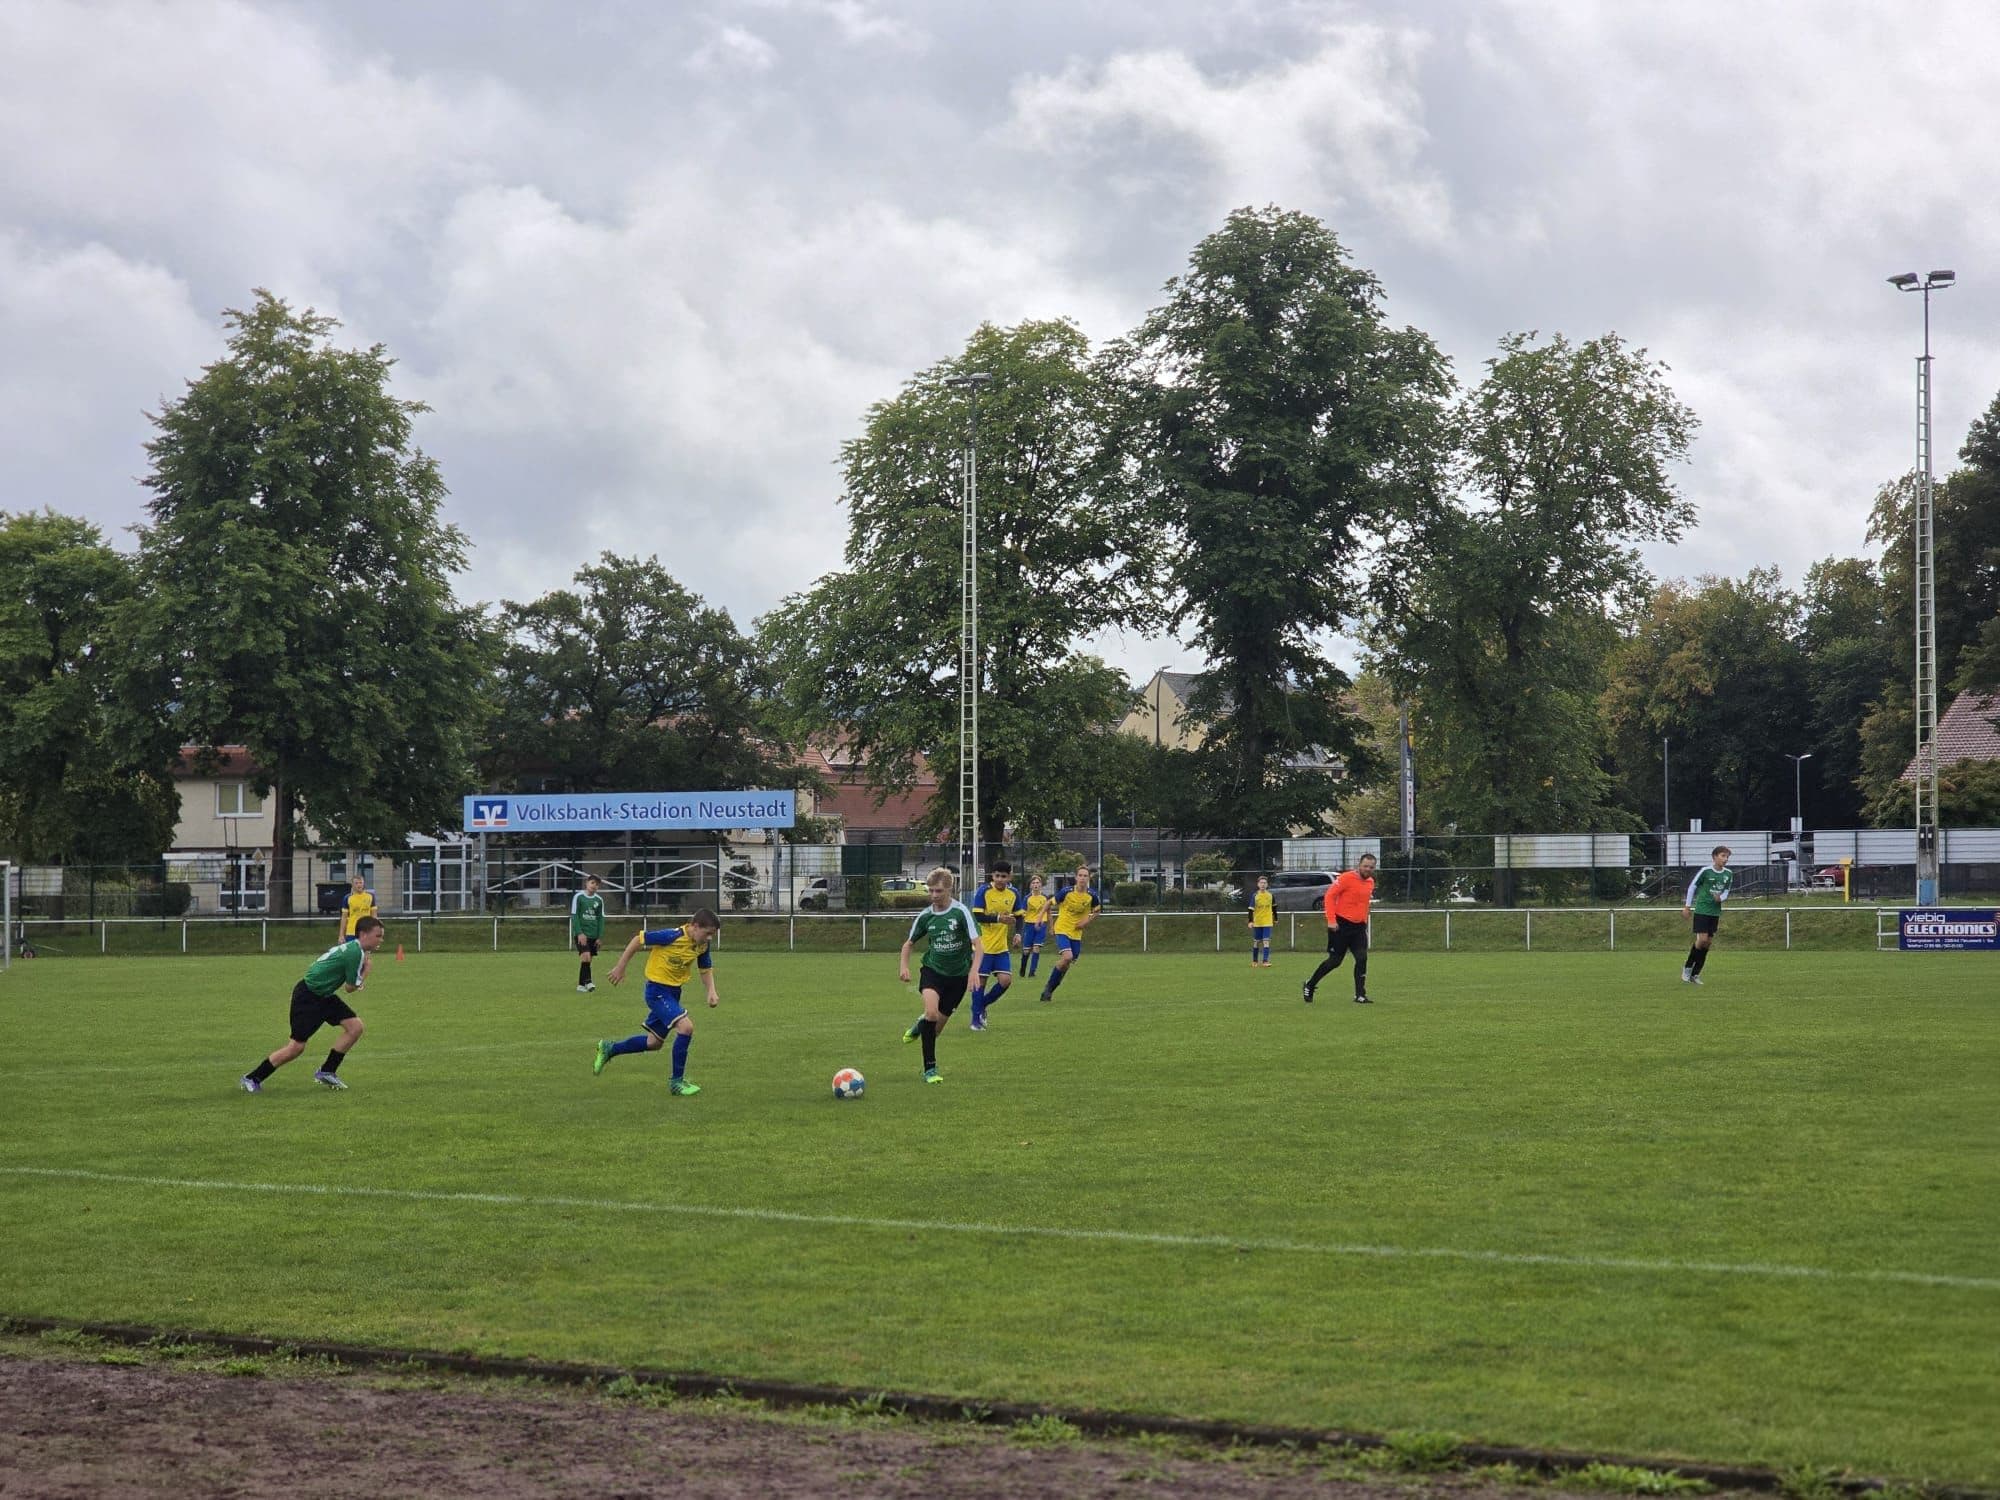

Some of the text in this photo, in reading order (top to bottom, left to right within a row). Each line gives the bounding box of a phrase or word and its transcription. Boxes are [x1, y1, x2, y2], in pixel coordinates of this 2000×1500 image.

[516, 800, 787, 821] Volksbank-Stadion Neustadt
[1905, 912, 1946, 924] viebig
[1906, 924, 1995, 935] ELECTRONICS
